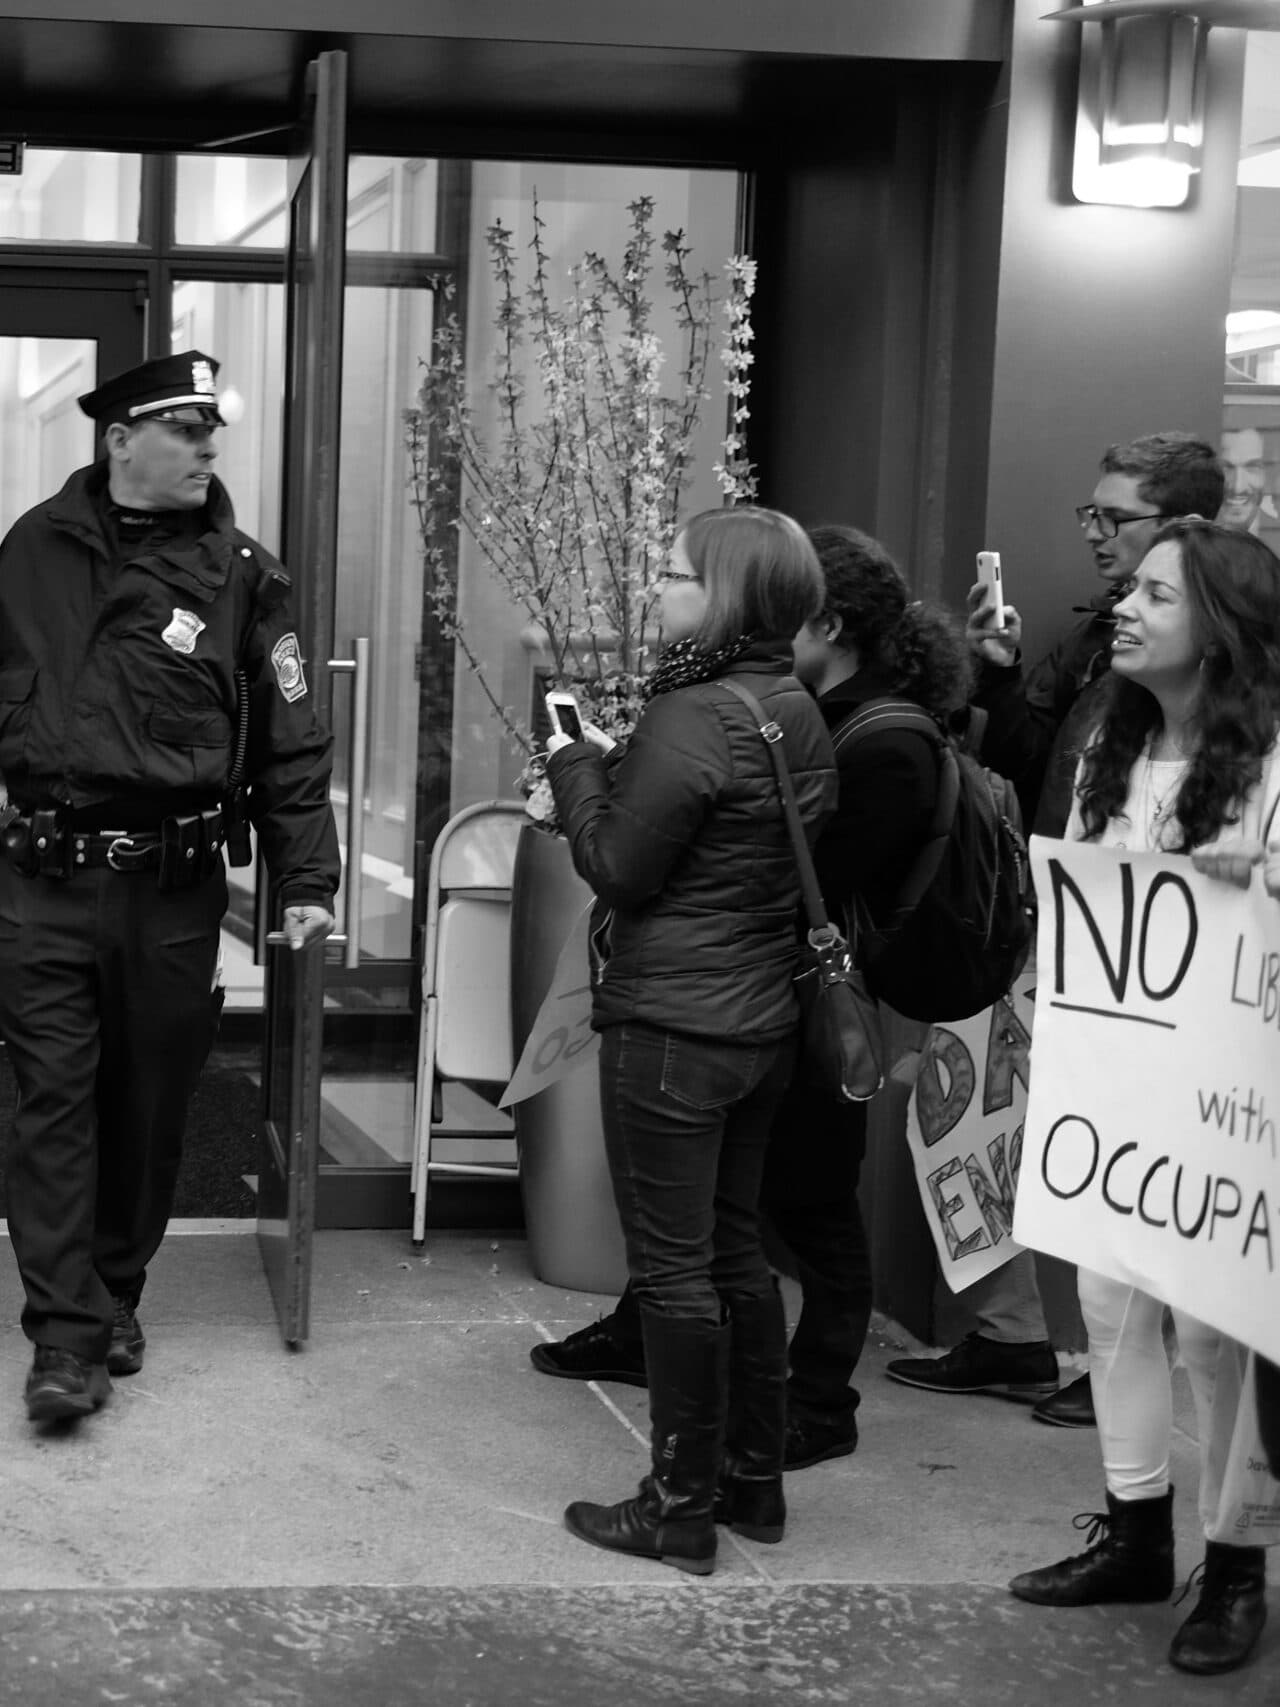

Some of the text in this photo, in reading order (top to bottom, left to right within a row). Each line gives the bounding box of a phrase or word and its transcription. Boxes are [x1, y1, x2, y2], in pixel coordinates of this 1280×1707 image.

[1047, 857, 1198, 1004] NO
[1230, 932, 1280, 1031] LIB
[1197, 1086, 1276, 1159] with
[1041, 1113, 1280, 1273] OCCUPA
